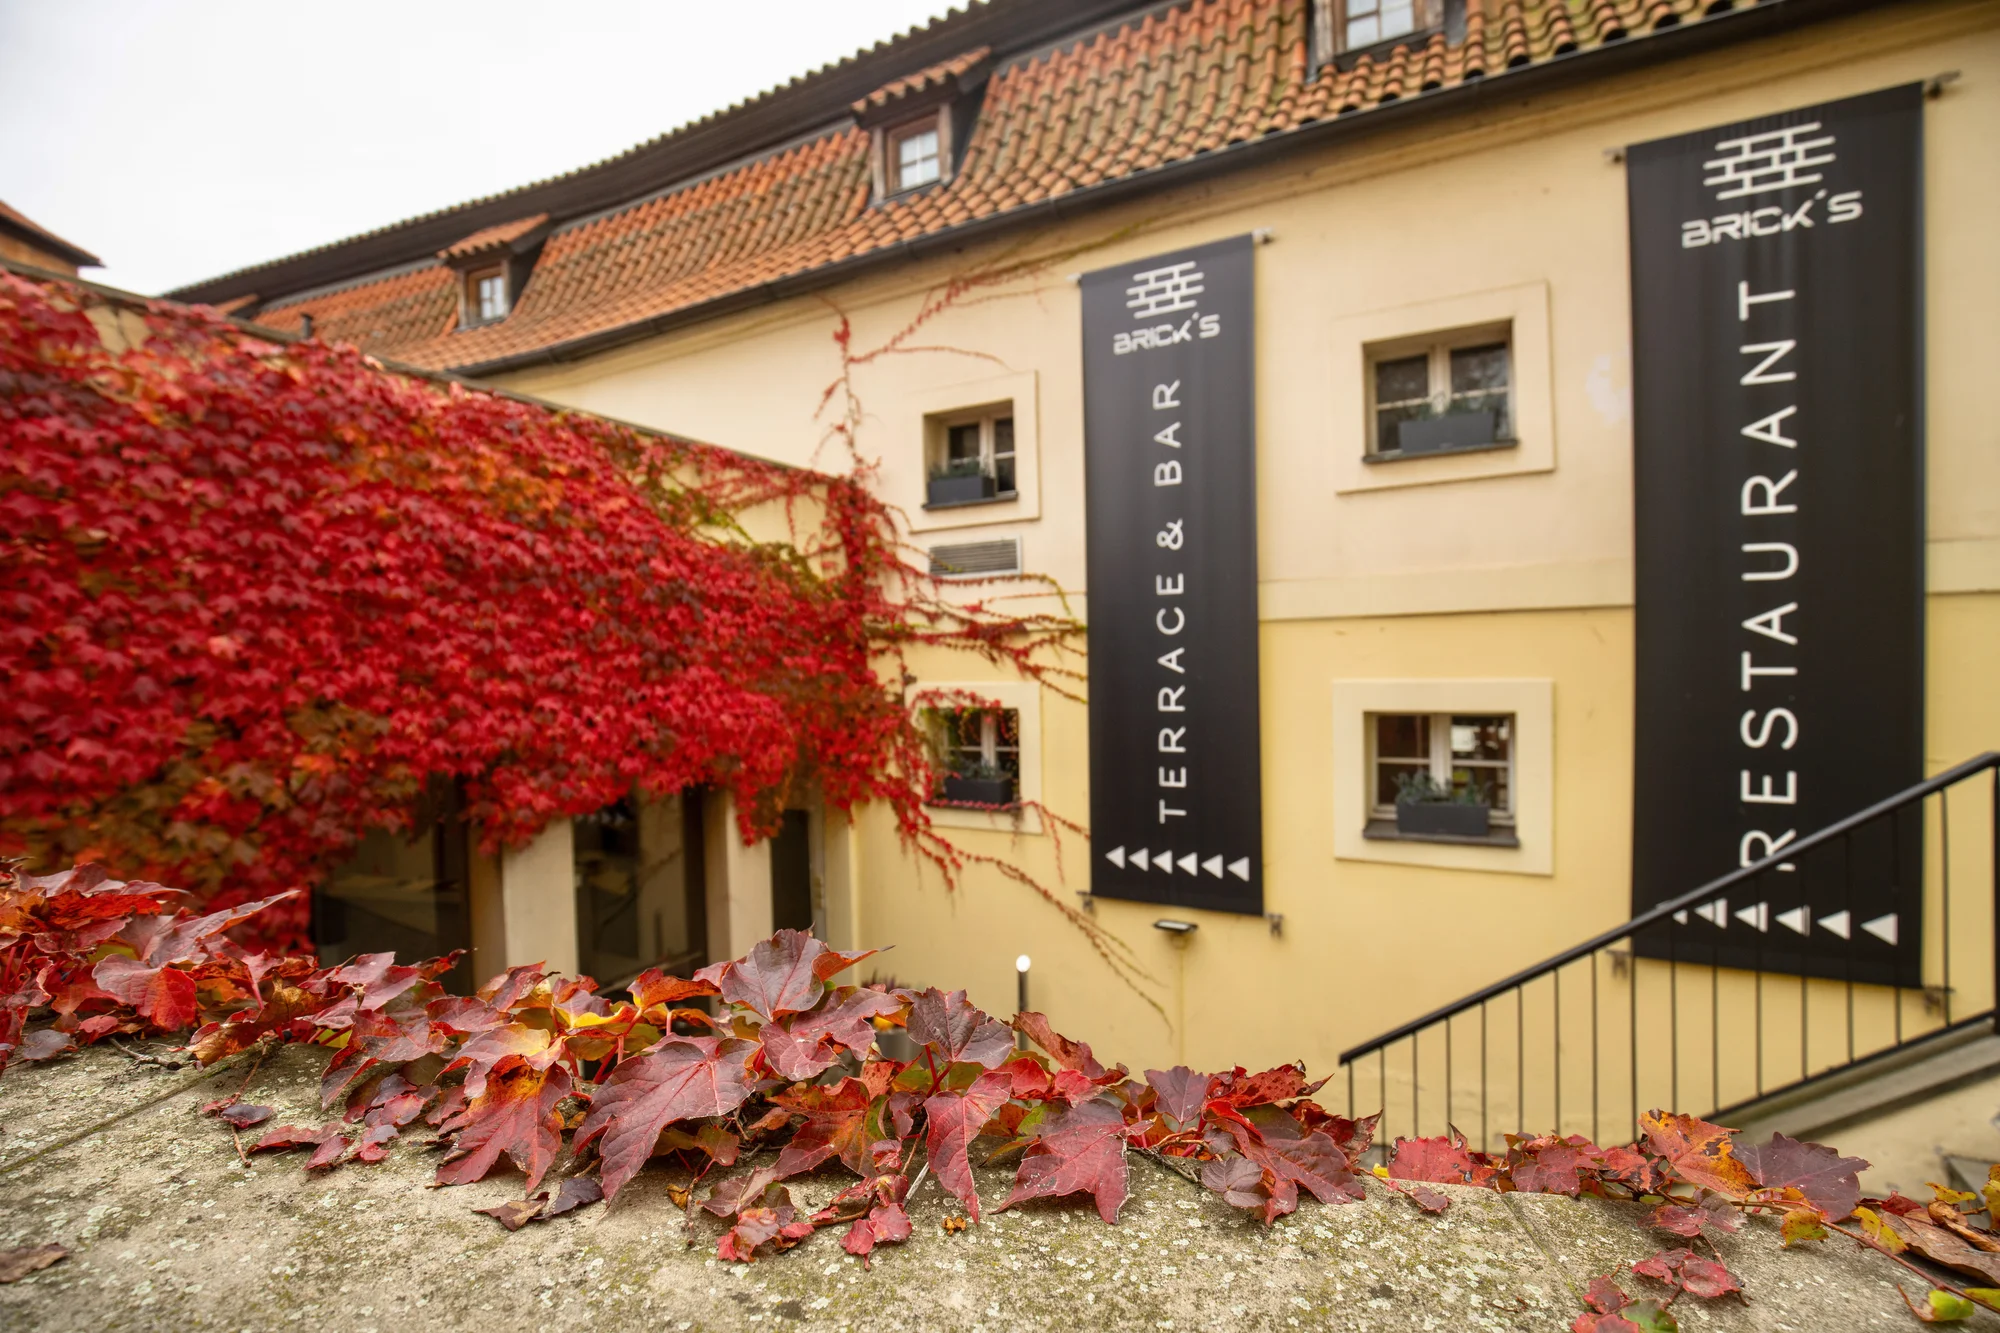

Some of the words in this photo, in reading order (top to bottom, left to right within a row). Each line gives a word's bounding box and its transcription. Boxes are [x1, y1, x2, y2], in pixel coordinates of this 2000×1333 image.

[1153, 379, 1182, 487] BAR
[1156, 518, 1184, 550] &
[1738, 280, 1799, 871] RESTAURANT
[1156, 572, 1187, 824] TERRACE
